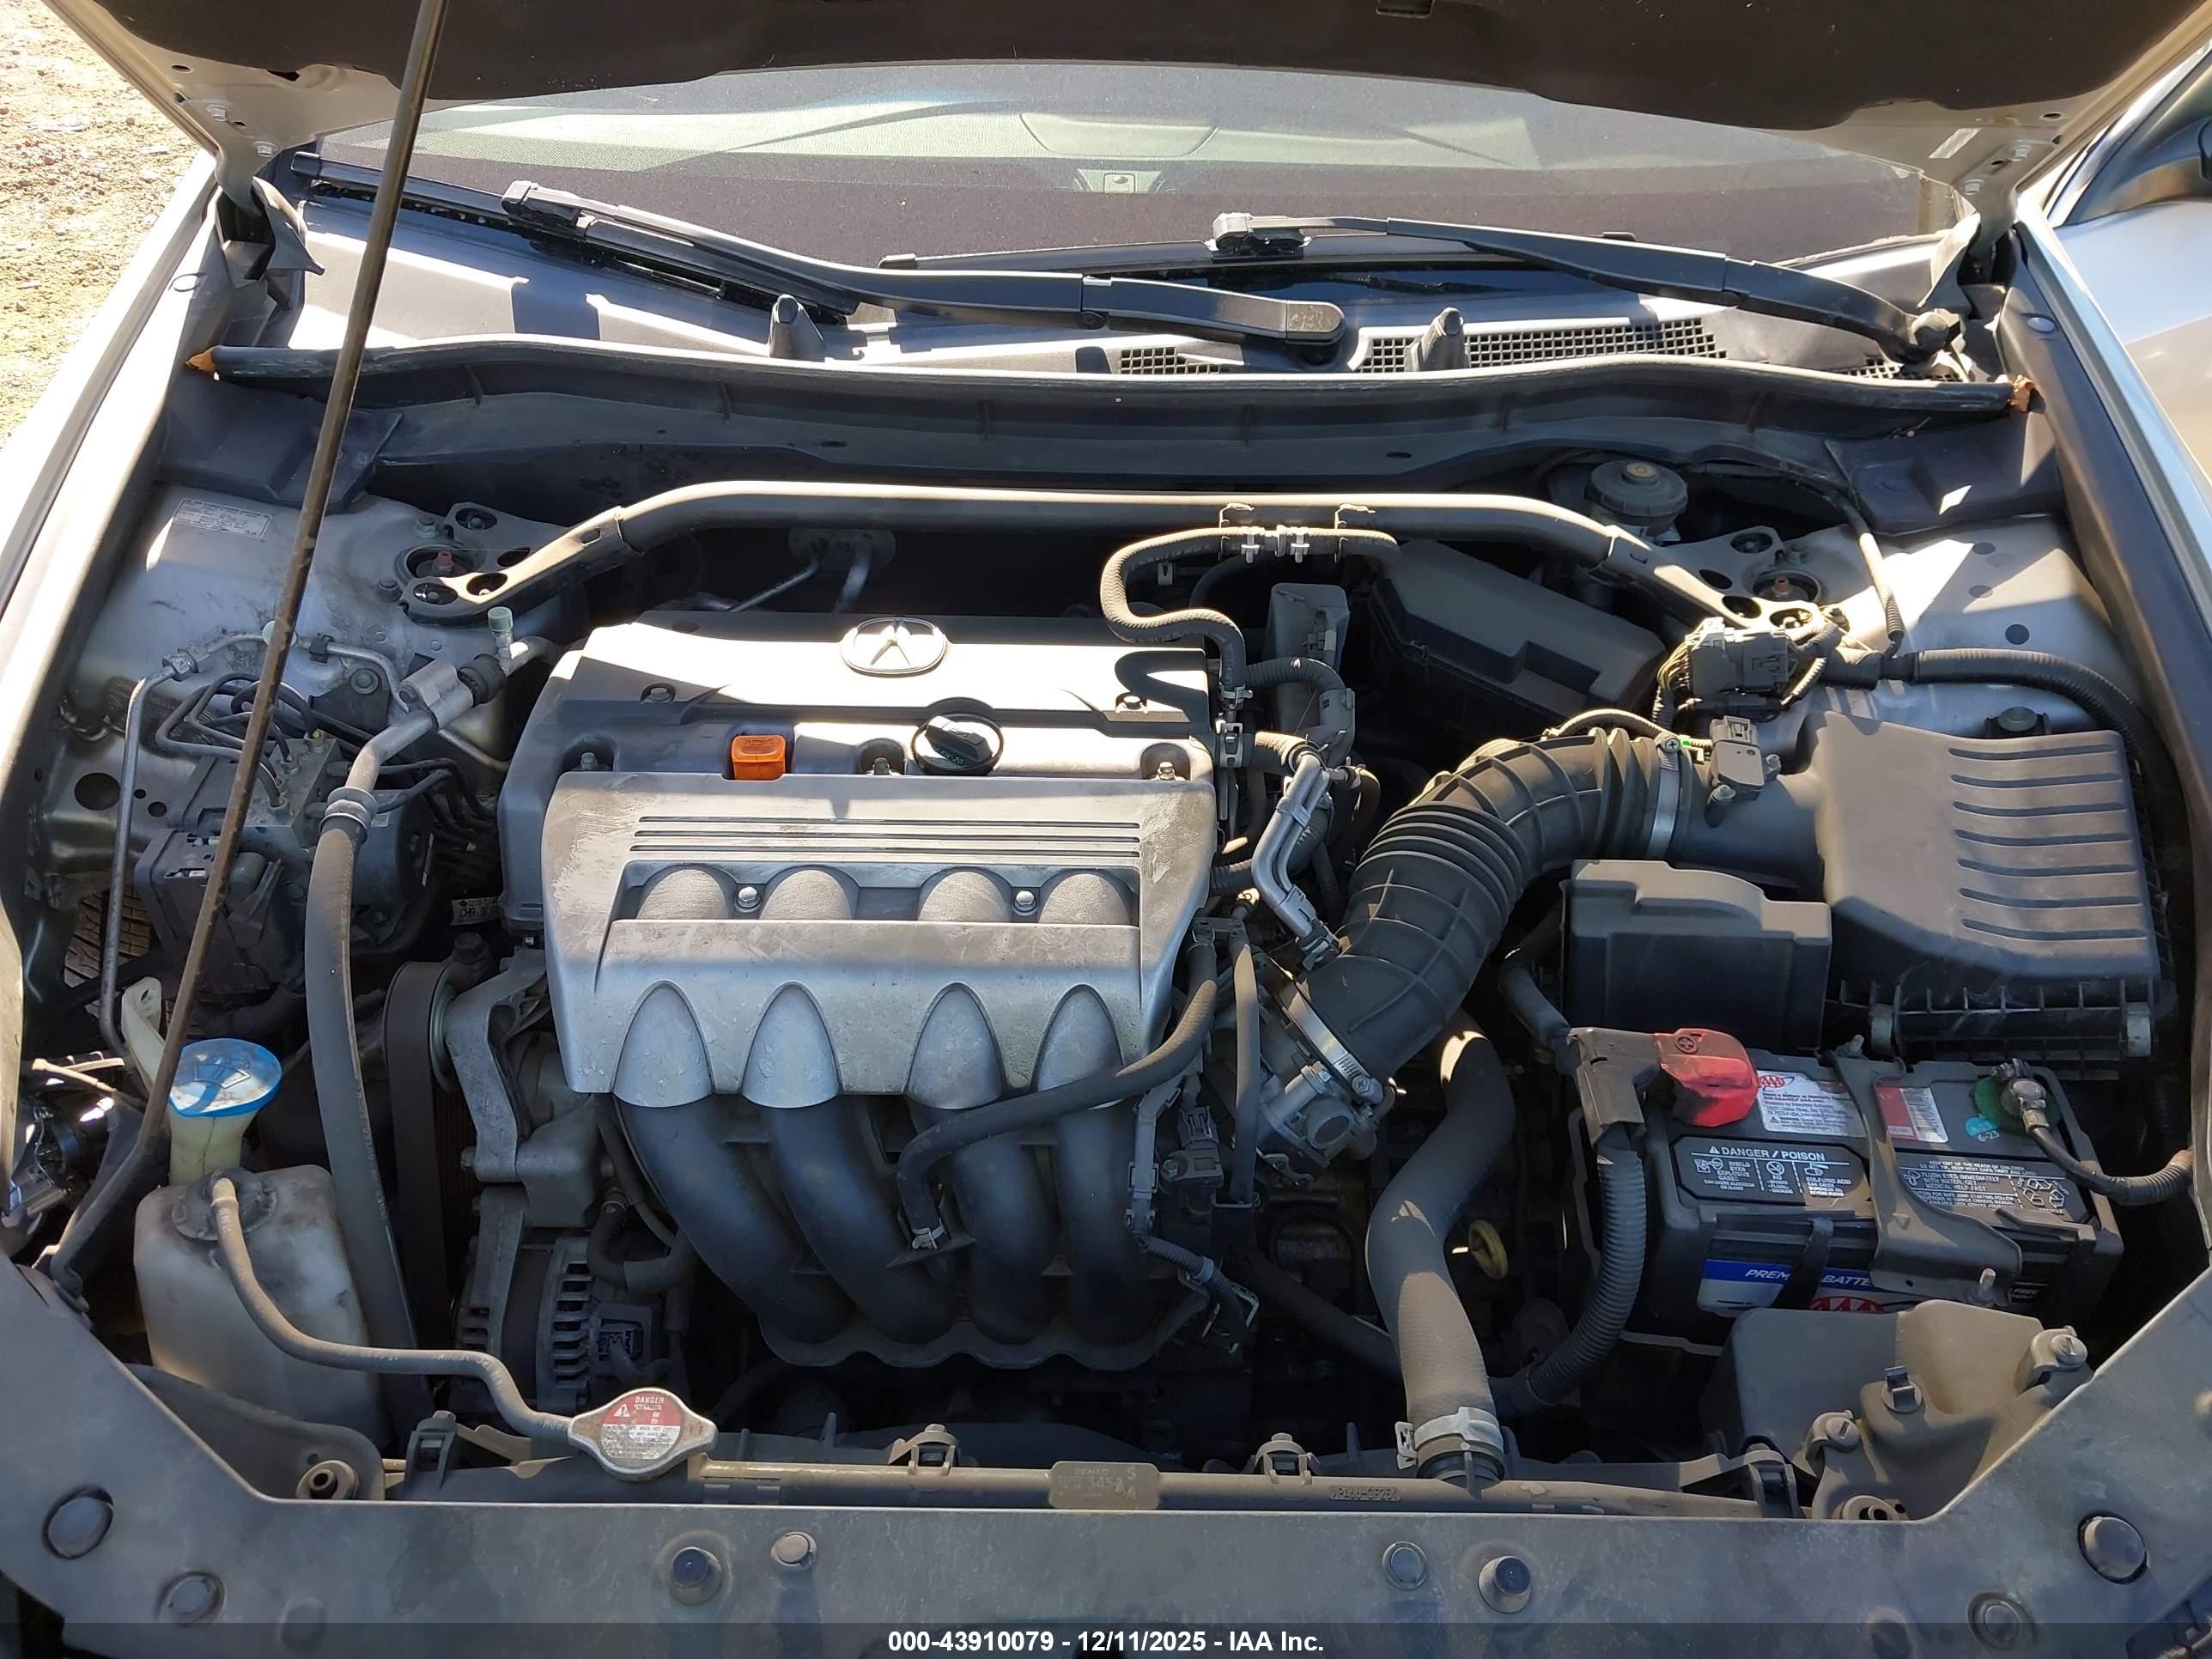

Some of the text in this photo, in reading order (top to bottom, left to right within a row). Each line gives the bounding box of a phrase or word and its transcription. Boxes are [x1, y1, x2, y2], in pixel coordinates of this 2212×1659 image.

[1978, 1130, 2000, 1142] 6-23
[1721, 1146, 1770, 1158] DANGER
[1781, 1151, 1826, 1161] POISON
[1745, 1269, 1870, 1286] PREM BATTE
